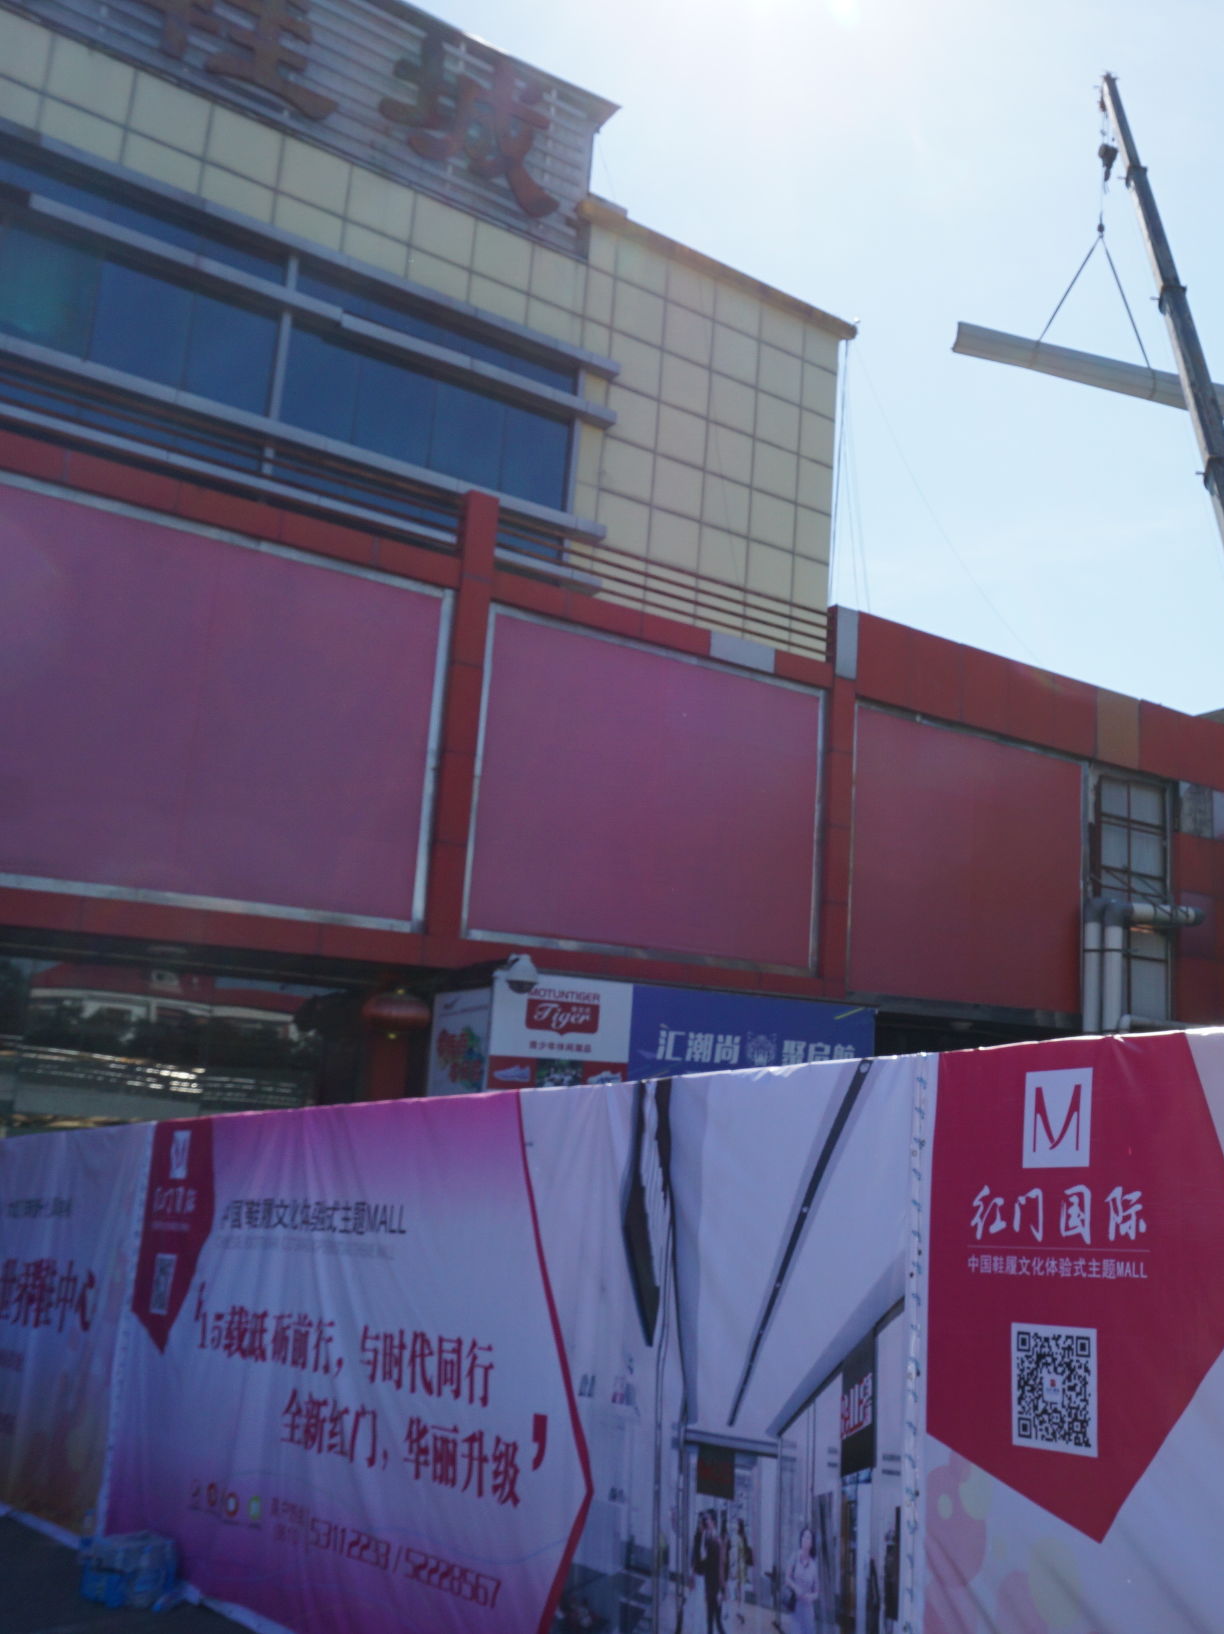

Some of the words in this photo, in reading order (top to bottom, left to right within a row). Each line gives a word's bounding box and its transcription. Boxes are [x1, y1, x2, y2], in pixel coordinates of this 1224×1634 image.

[533, 1002, 592, 1030] Tiger
[656, 1030, 741, 1065] 汇潮尚
[968, 1183, 1147, 1244] 红门国际
[967, 1254, 1148, 1280] 中国鞋履文化体验式主题MALL
